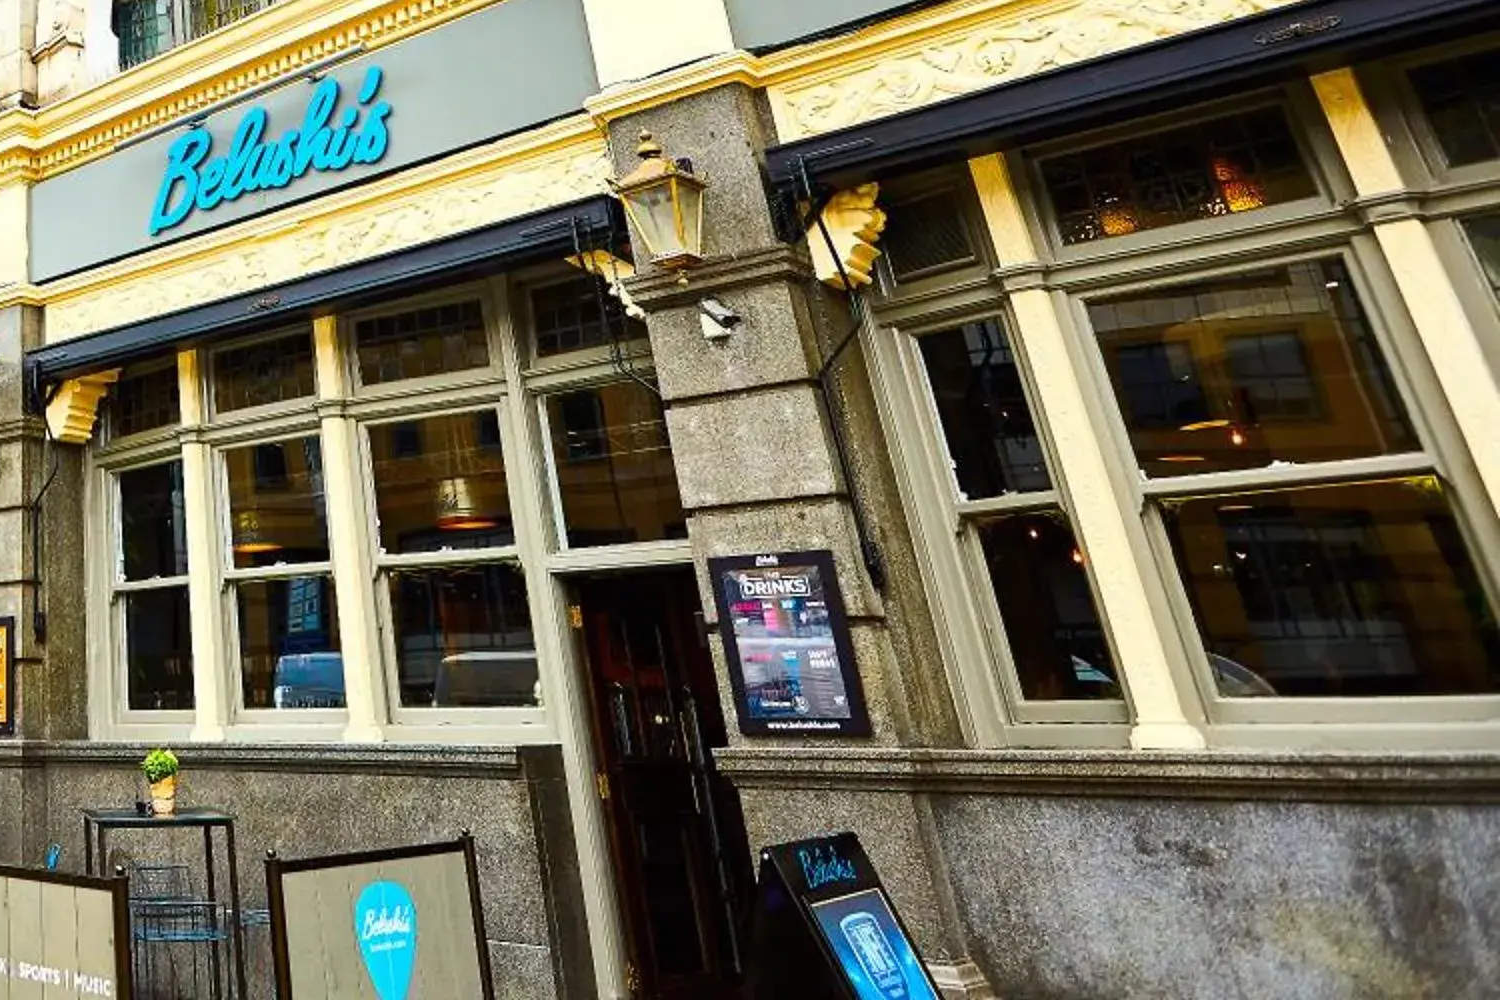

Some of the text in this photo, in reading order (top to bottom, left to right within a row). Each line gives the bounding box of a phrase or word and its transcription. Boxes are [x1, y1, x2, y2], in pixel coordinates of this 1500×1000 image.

[148, 64, 392, 237] Belushi's
[744, 579, 808, 595] DRINKS
[73, 971, 113, 997] MUSIC
